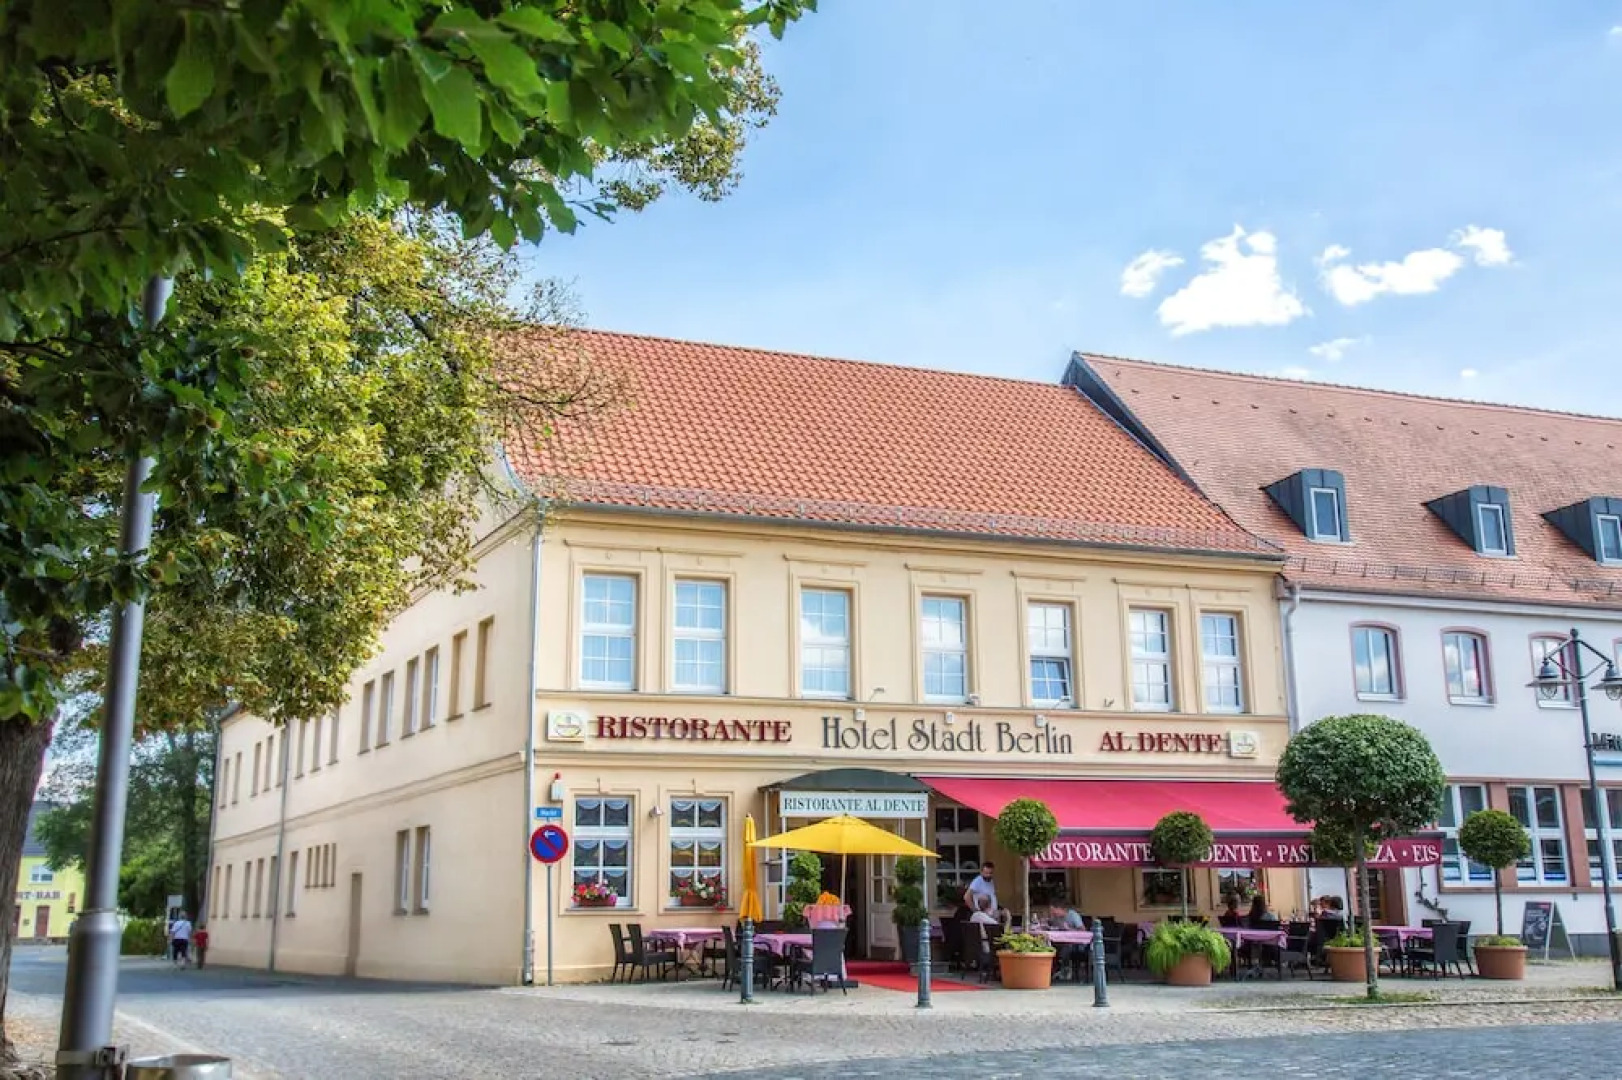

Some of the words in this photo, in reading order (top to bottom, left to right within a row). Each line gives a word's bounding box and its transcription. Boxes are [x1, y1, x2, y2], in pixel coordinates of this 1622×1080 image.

[596, 716, 792, 742] RISTORANTE
[821, 716, 898, 750] Hotel
[907, 719, 986, 752] Stadt
[996, 722, 1073, 754] Berlin
[1099, 731, 1132, 752] AL
[1138, 732, 1221, 754] DENTE
[784, 797, 863, 812] RISTORANTE
[864, 799, 882, 812] AL
[883, 799, 925, 812] DENTE
[1412, 844, 1440, 862] EIS
